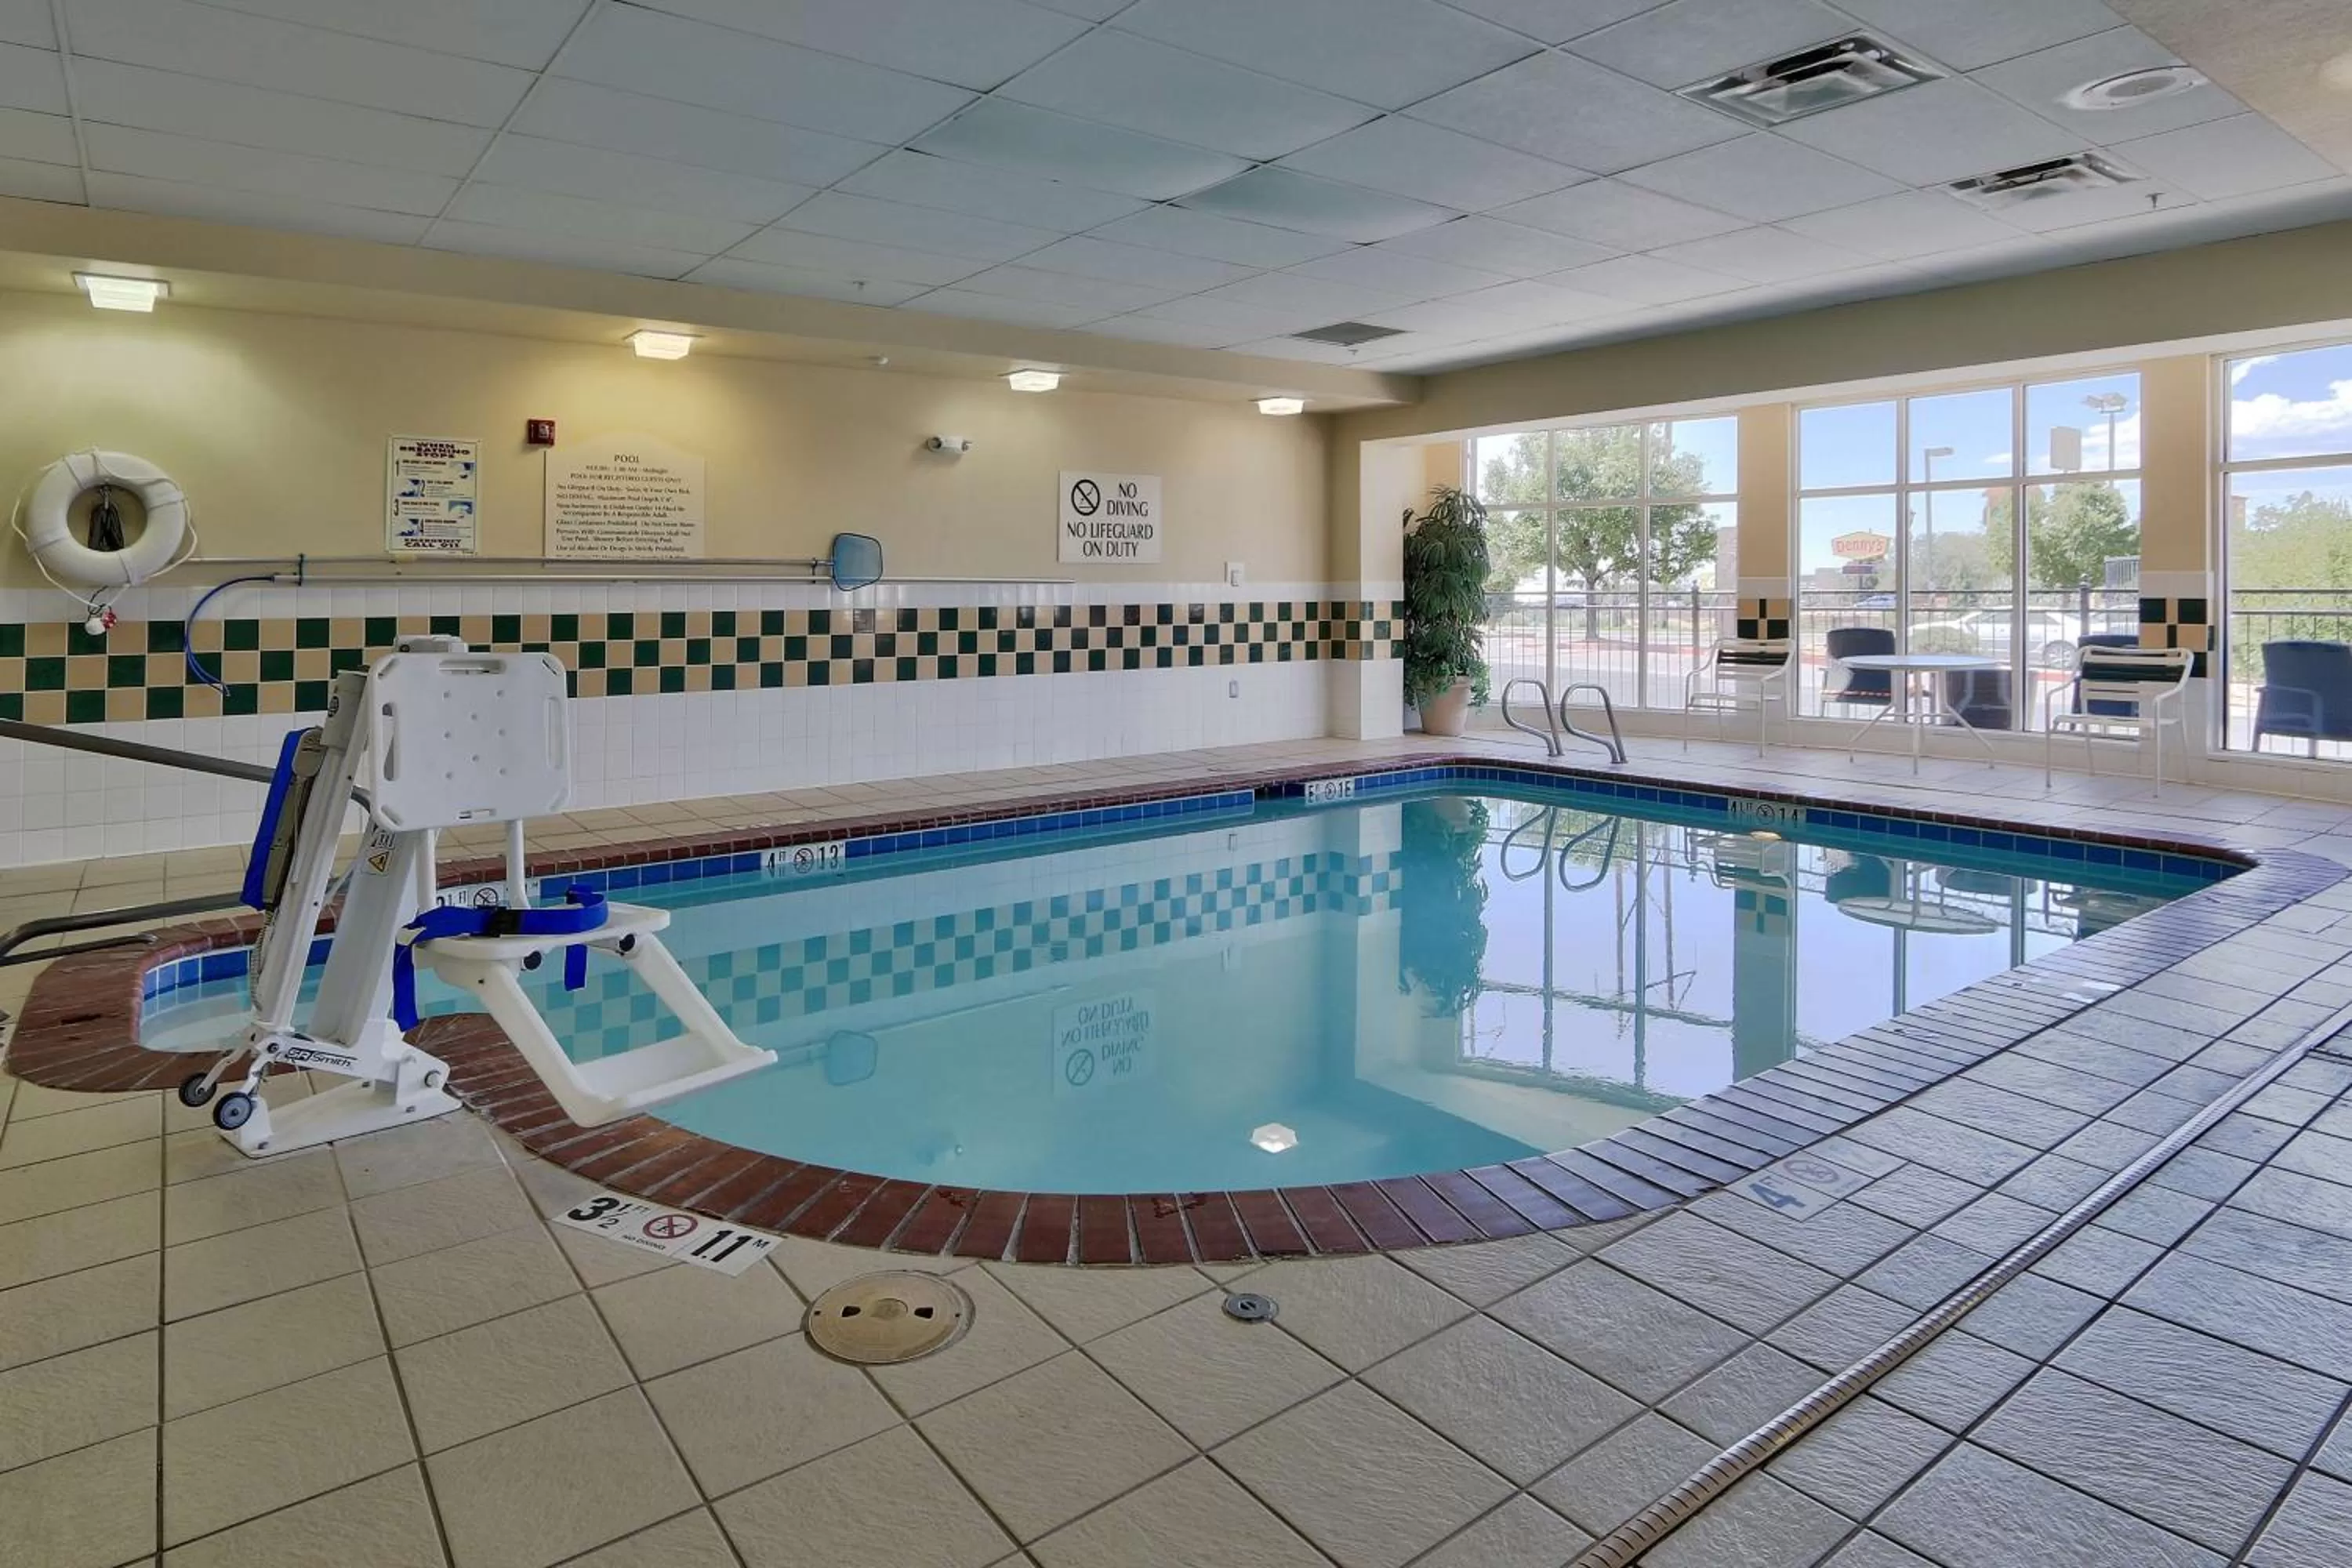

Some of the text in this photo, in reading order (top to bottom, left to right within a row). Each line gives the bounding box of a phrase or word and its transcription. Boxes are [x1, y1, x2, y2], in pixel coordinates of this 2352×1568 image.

[400, 446, 470, 455] BREATHING
[1119, 482, 1138, 499] NO
[1106, 499, 1149, 517] DIVING
[1067, 521, 1153, 539] NO LIFEGUARD
[1083, 540, 1139, 557] ON DUTY
[1836, 539, 1883, 553] Denny's
[1748, 1182, 1806, 1208] 4
